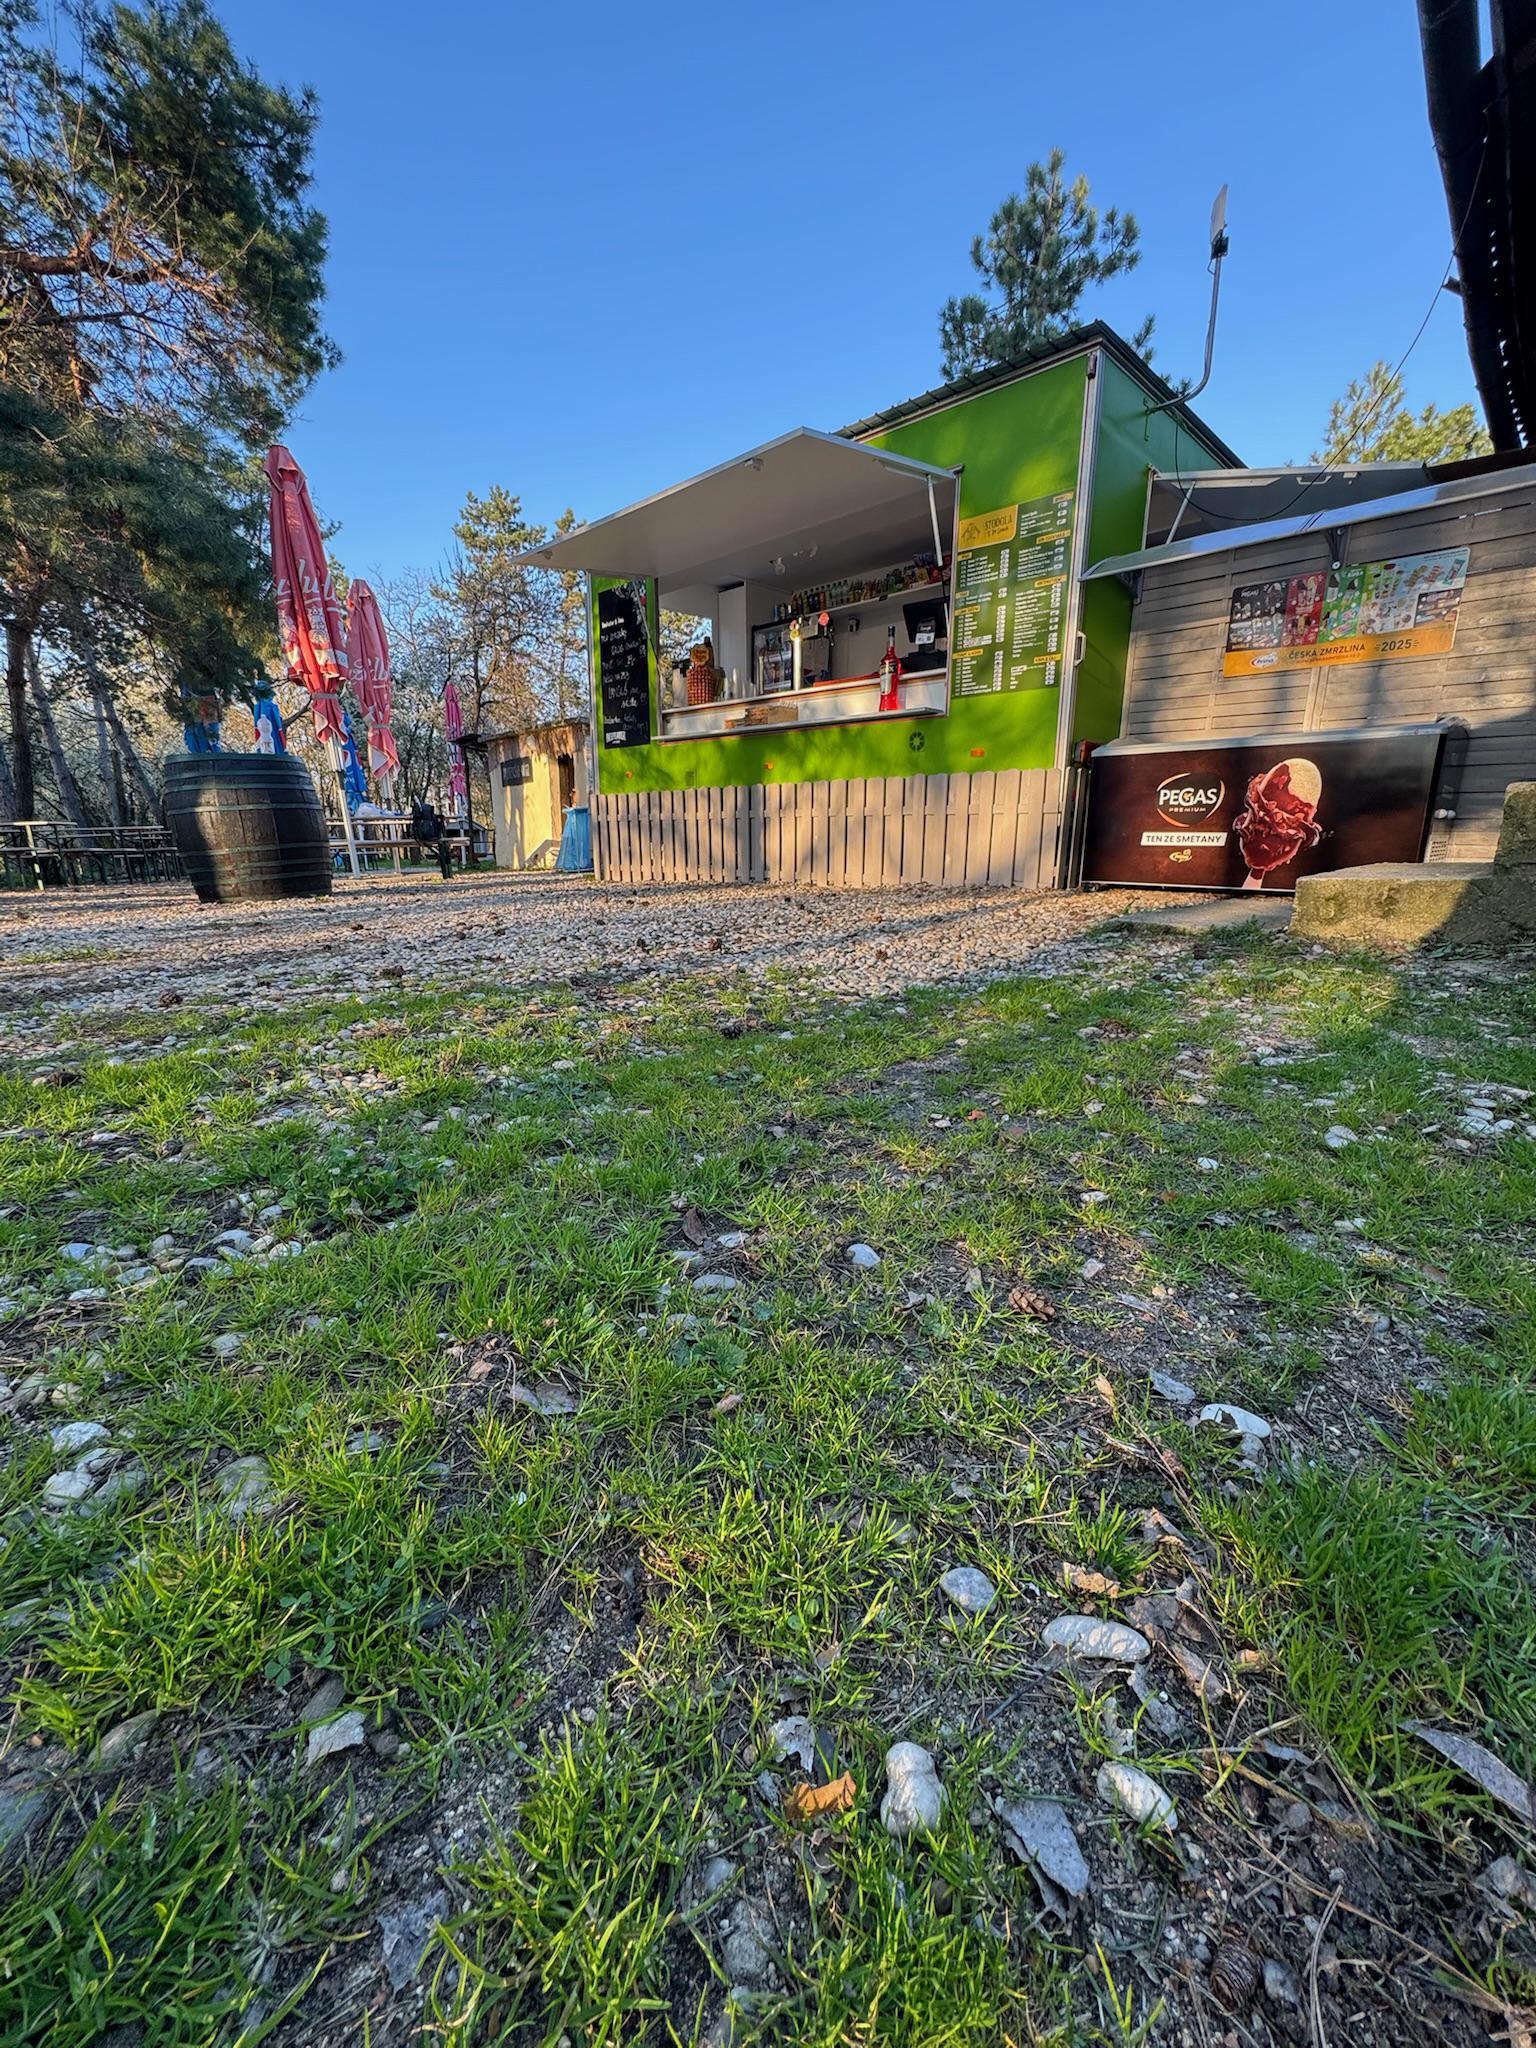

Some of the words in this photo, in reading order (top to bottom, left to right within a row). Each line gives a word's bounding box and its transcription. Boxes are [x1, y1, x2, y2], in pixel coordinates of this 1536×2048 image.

[1288, 649, 1318, 660] ČESKÁ
[1319, 643, 1366, 657] ZMRZLINA
[1381, 639, 1412, 652] 2025
[1159, 787, 1218, 807] PEGAS
[1146, 835, 1162, 843] TEN
[1163, 835, 1175, 843] ZE
[1176, 835, 1222, 843] SMETANY
